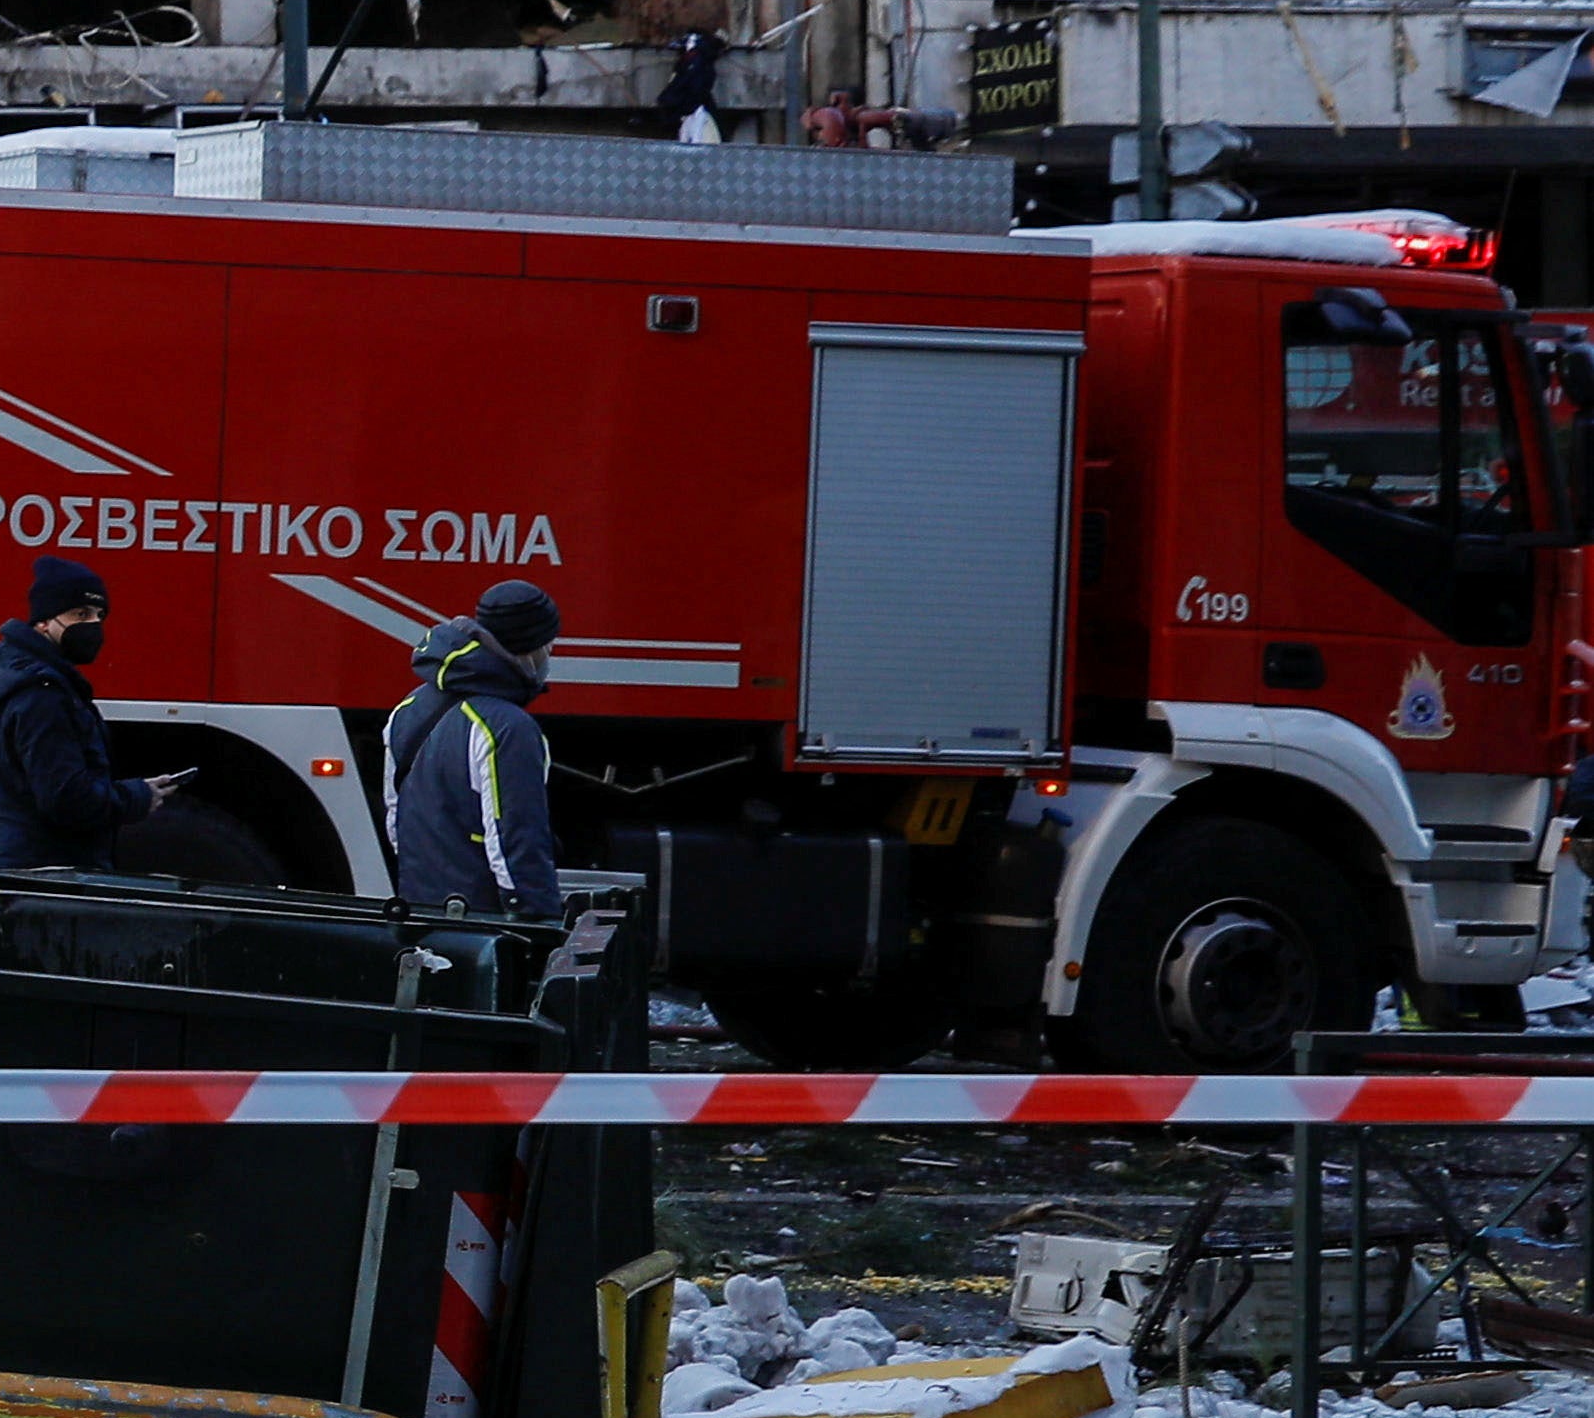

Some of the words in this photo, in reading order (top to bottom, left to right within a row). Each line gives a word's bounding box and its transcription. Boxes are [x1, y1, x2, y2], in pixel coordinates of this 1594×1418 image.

[975, 39, 1054, 76] ΣΧΟΛΗ
[976, 77, 1057, 115] ΧΟΡΟΥ
[382, 509, 562, 566] ΣΩΜΑ
[1196, 592, 1249, 622] 199
[1467, 663, 1522, 683] 410
